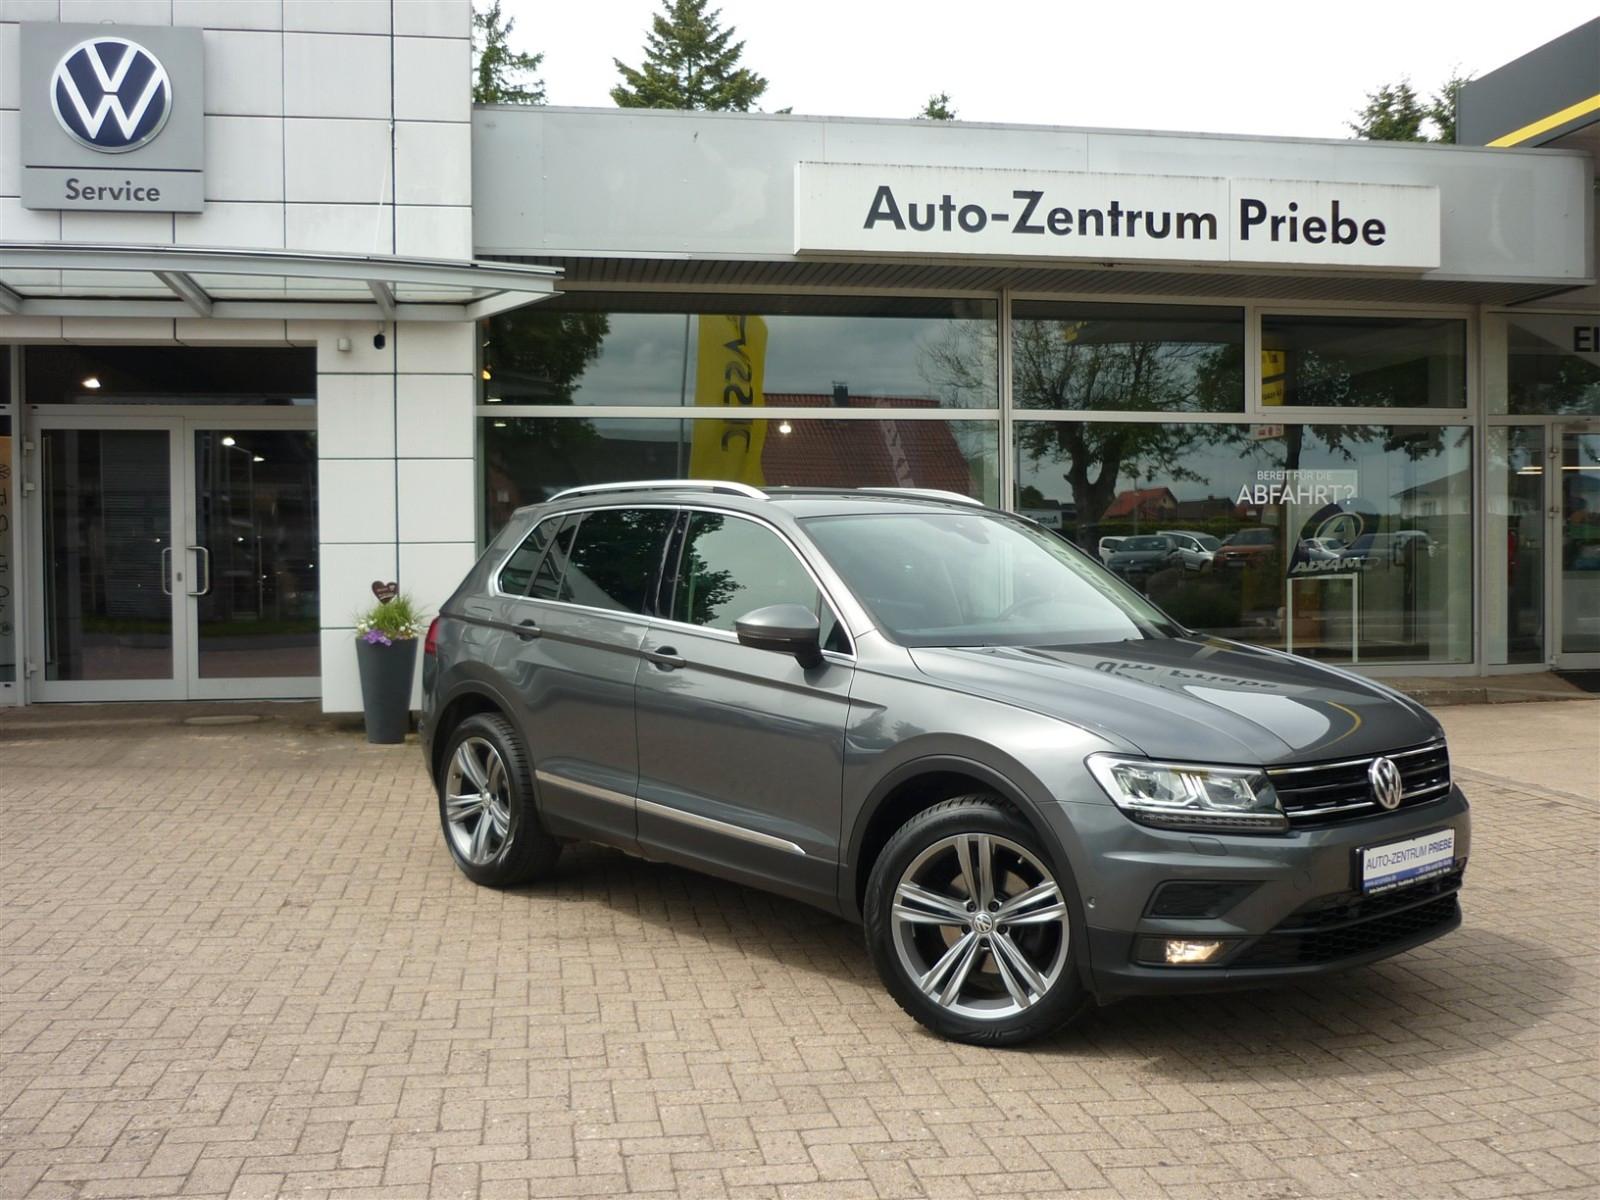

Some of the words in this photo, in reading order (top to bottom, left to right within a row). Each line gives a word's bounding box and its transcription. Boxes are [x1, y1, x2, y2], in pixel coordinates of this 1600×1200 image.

[65, 178, 161, 203] Service
[863, 185, 1218, 241] Auto-Zentrum
[1240, 198, 1386, 247] Priebe
[1257, 470, 1290, 480] BEREIT
[1293, 469, 1315, 480] FÜR
[1236, 484, 1354, 505] ABFAHRT?
[1366, 845, 1427, 870] AUTO-ZENTRUM
[1428, 837, 1453, 854] PRIEBE
